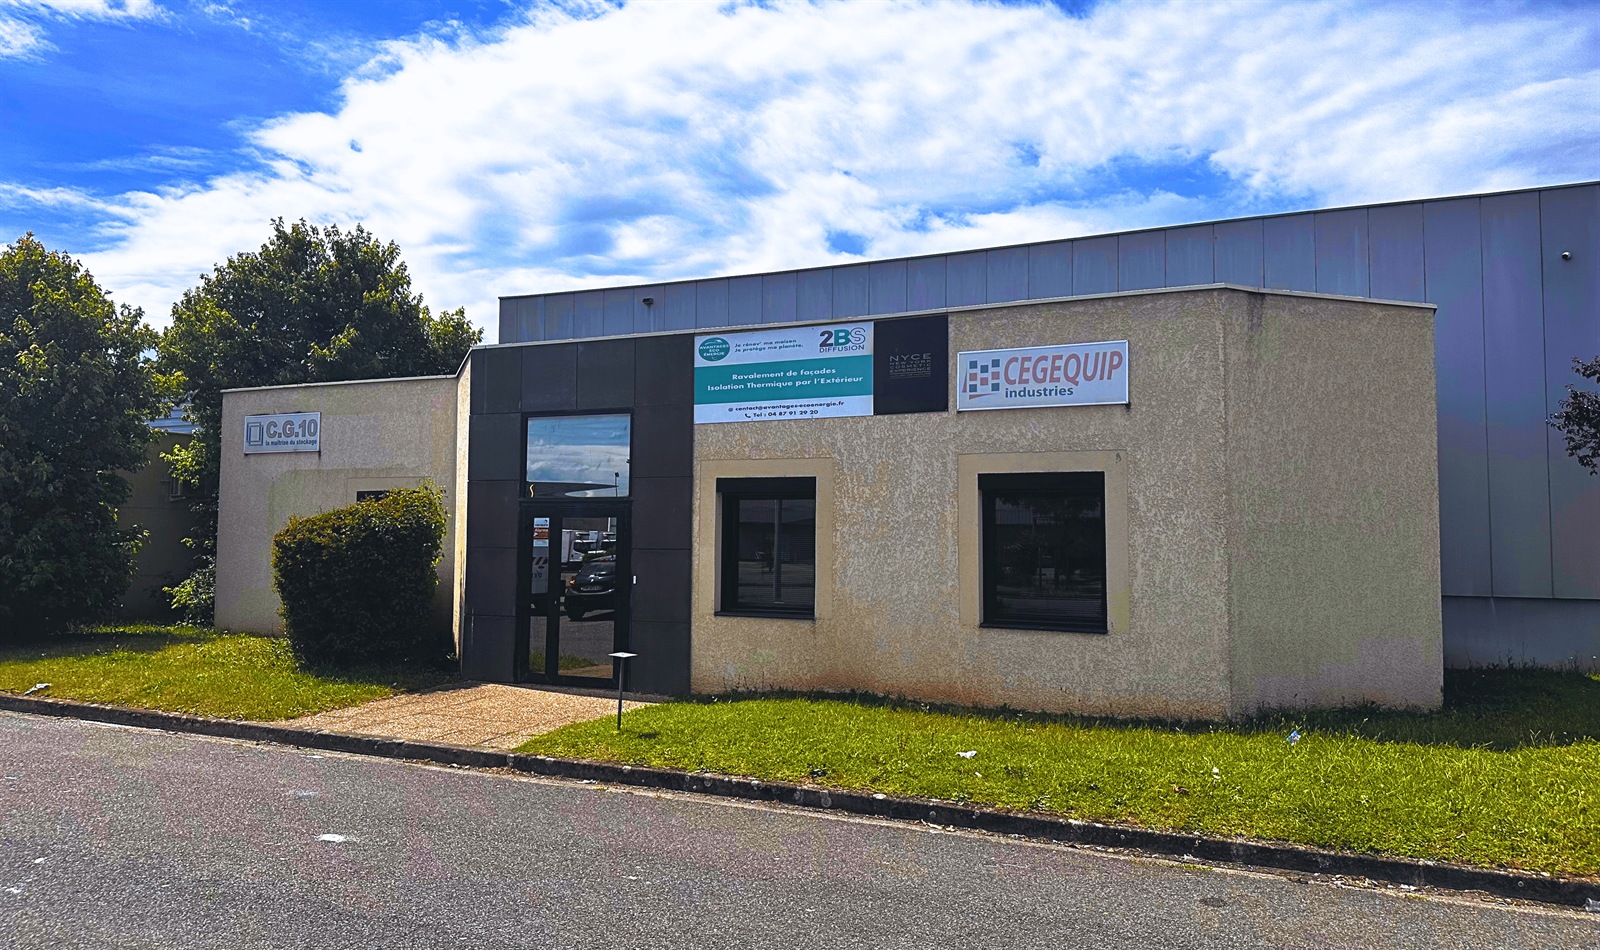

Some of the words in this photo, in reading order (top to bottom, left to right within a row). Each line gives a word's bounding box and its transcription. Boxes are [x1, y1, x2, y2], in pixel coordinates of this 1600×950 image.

[819, 327, 866, 347] 2BS
[819, 344, 865, 353] DIFFUSION
[889, 352, 931, 361] NYCE
[732, 371, 784, 380] Ravalement
[800, 368, 836, 377] façades
[1003, 350, 1124, 387] CEGEQUIP
[707, 383, 744, 391] Isolation
[746, 380, 793, 389] Thermique
[795, 379, 812, 387] par
[1005, 385, 1074, 398] industries
[735, 401, 845, 412] contact@avantages-ecoenergie.fr
[266, 418, 318, 439] C.G.10
